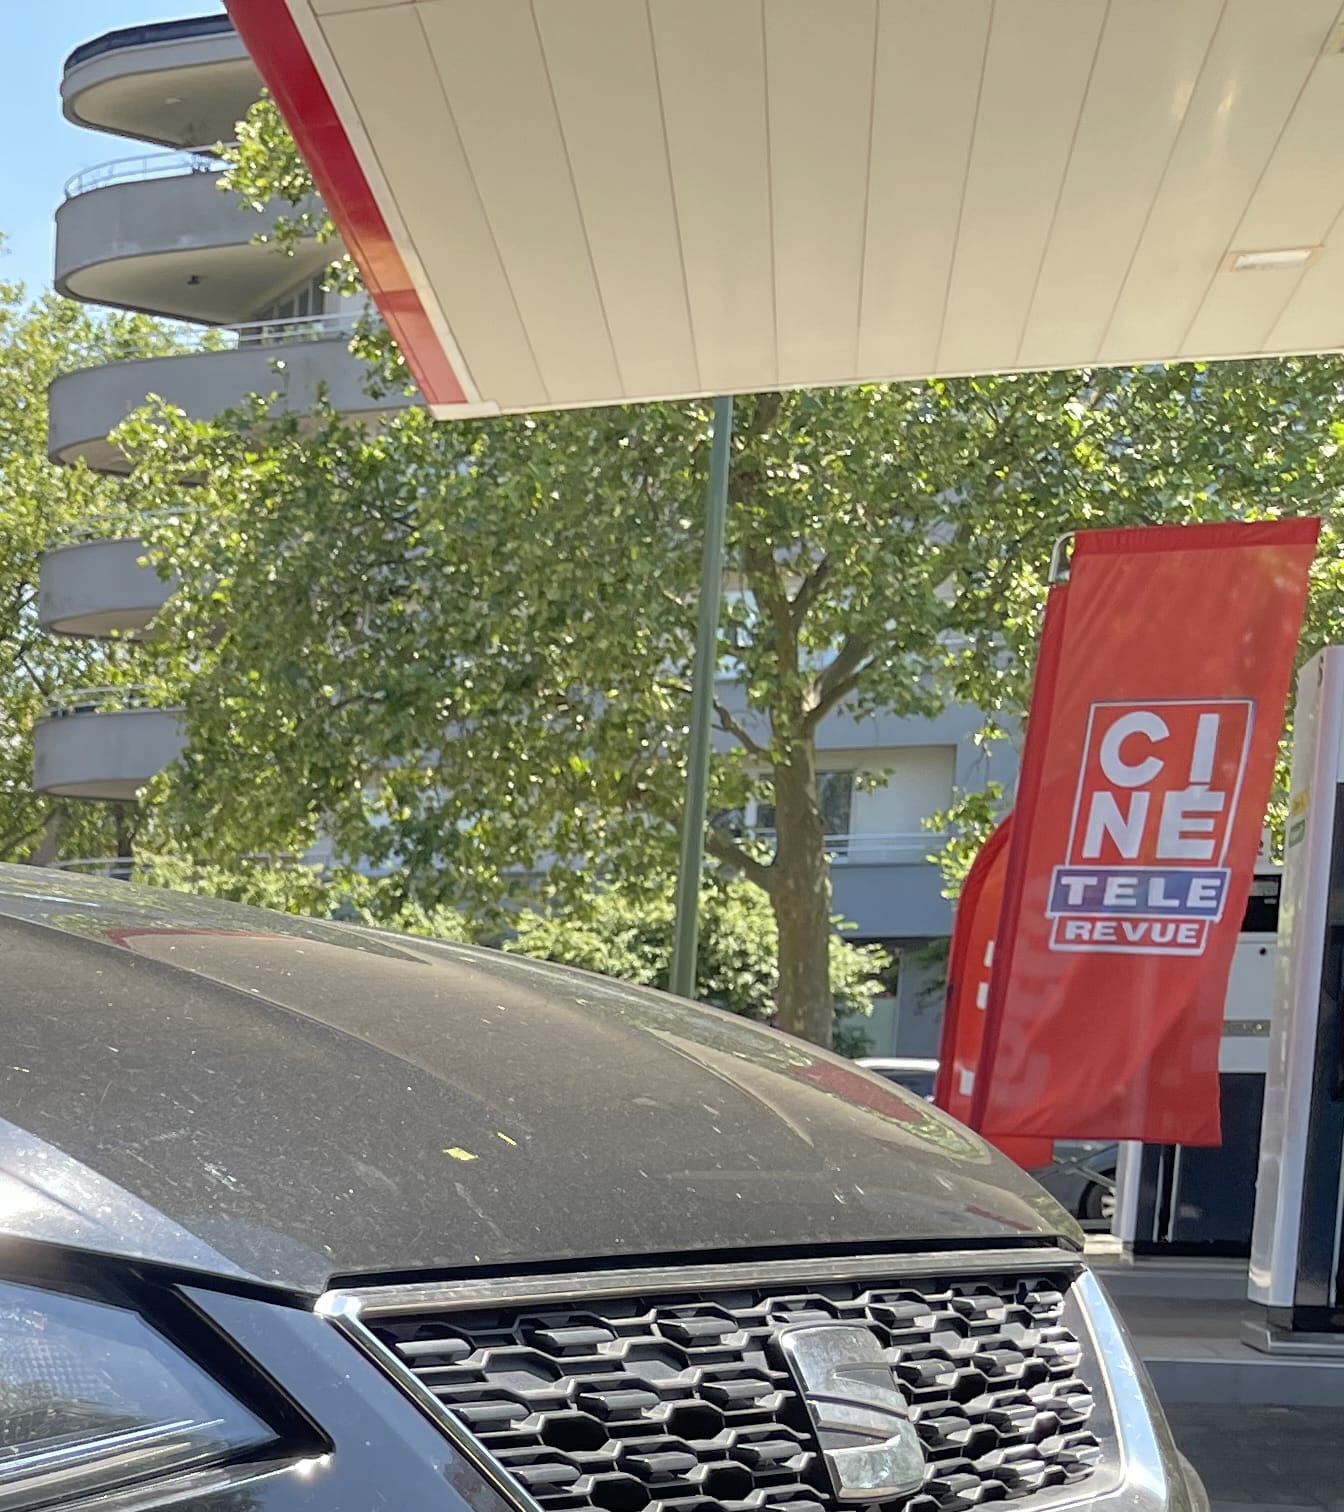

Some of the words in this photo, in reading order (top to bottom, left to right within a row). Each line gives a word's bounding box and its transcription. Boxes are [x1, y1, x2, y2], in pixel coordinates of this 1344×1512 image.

[1099, 710, 1220, 788] CI
[1081, 785, 1226, 860] NÉ
[1060, 876, 1222, 908] TELE
[1064, 920, 1201, 944] REVUE
